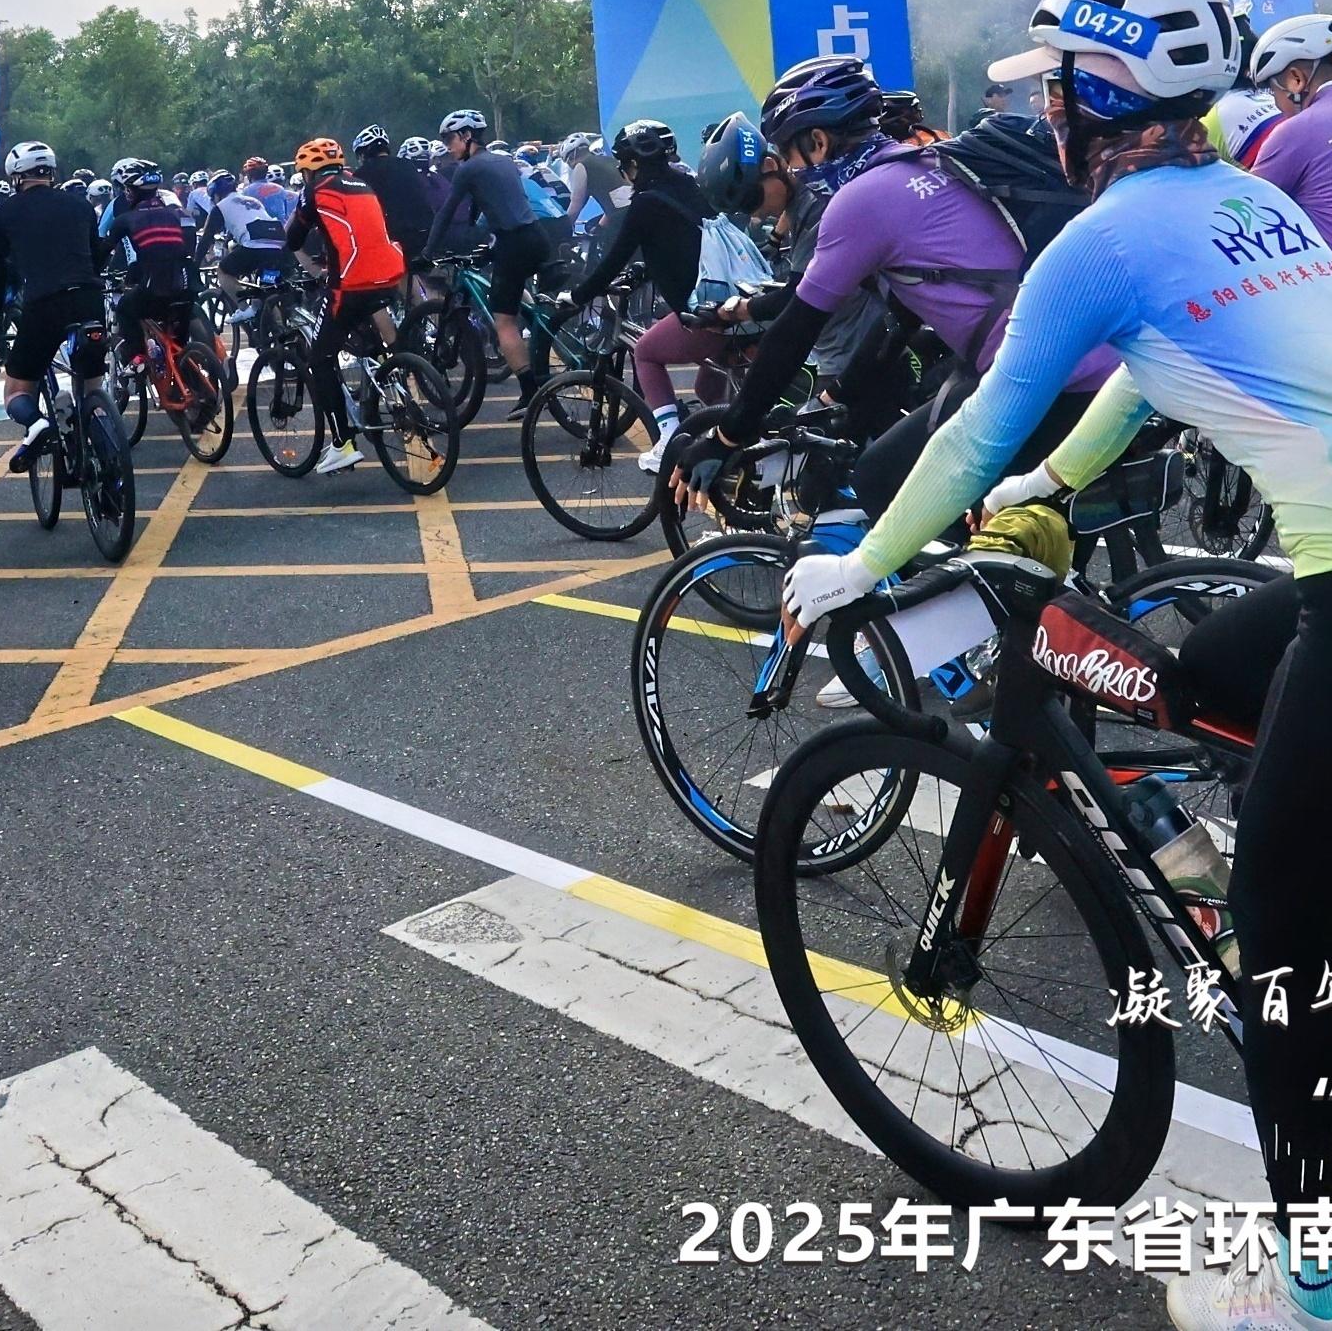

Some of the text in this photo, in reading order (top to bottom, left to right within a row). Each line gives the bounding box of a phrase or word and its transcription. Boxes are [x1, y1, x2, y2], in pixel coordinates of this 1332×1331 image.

[1074, 3, 1143, 46] 0479
[1211, 223, 1321, 266] HYZX
[920, 867, 956, 953] QUICK
